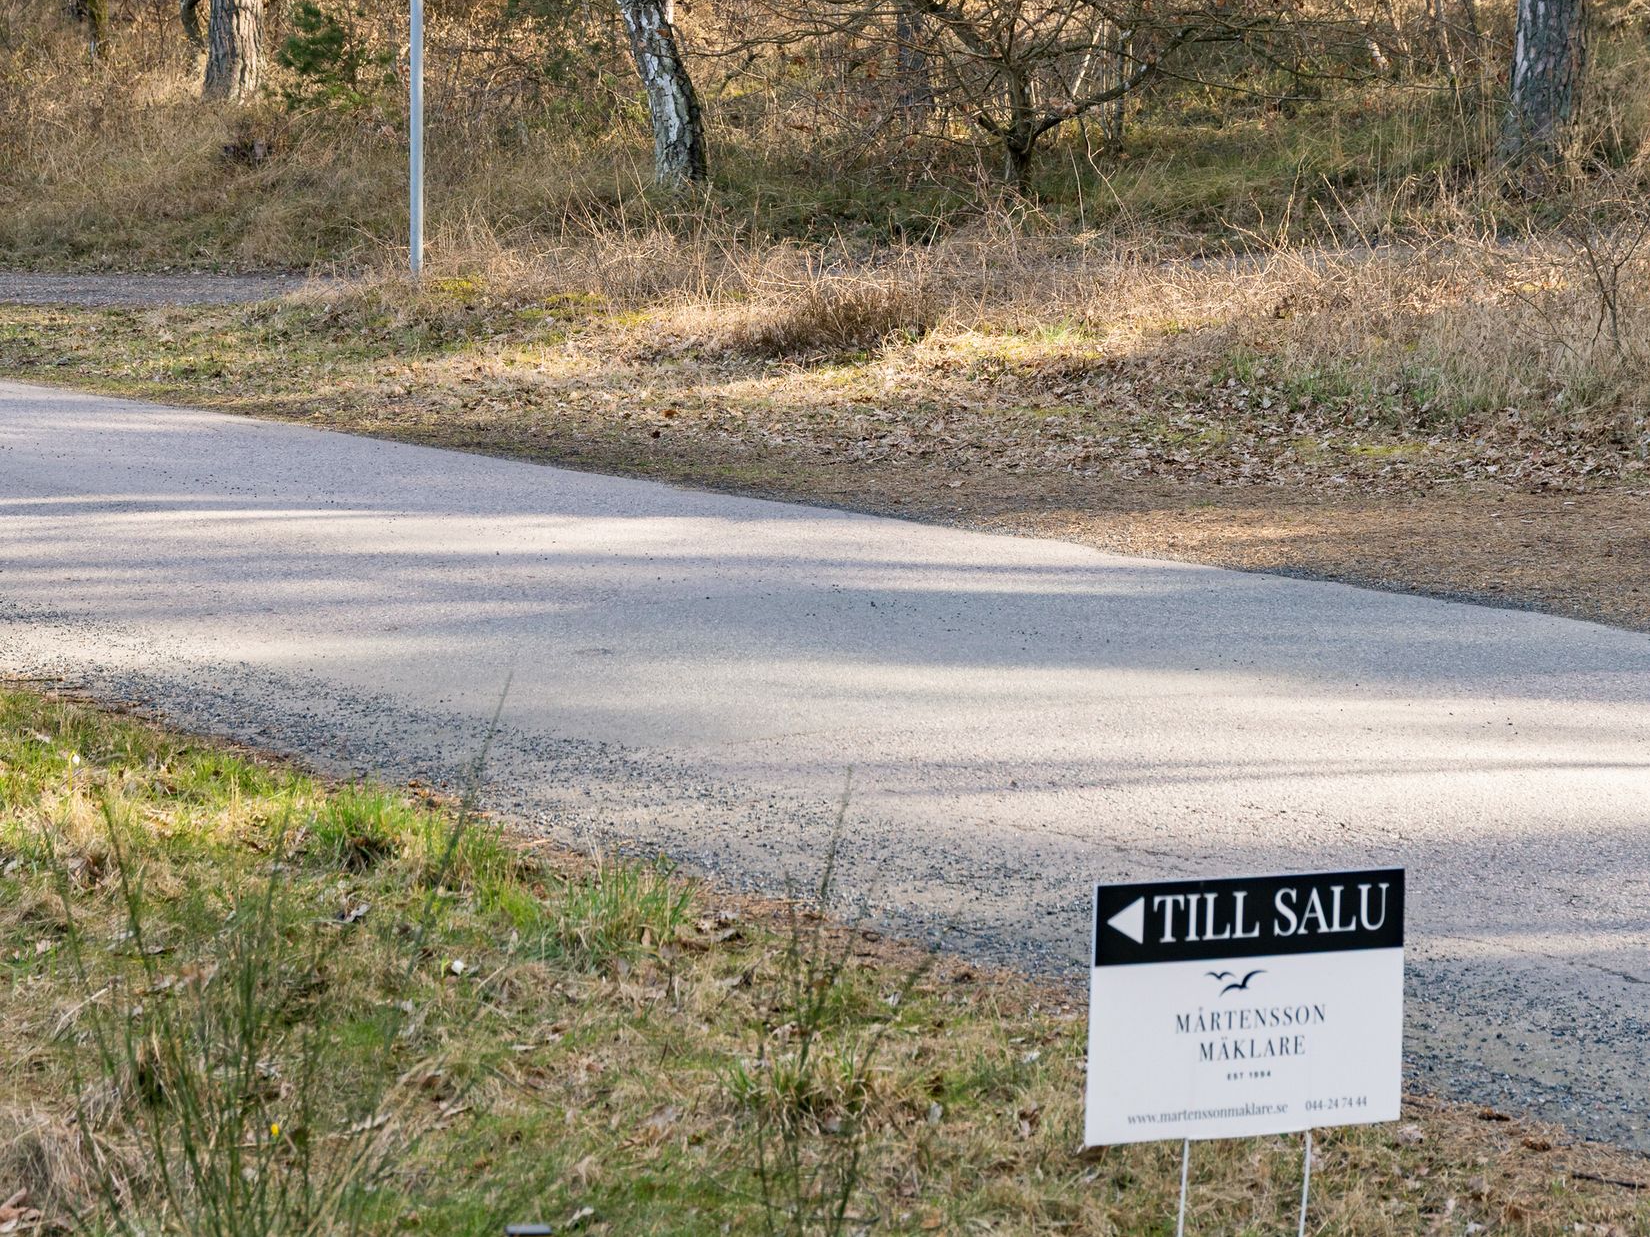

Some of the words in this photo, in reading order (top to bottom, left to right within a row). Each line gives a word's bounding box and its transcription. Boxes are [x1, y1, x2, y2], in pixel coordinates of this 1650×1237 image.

[1153, 891, 1260, 943] TILL
[1273, 882, 1390, 937] SALU
[1175, 1004, 1326, 1034] MÅRTENSSON
[1199, 1034, 1306, 1062] MÄKLARE
[1127, 1102, 1289, 1125] www.martenssonmaklare.se
